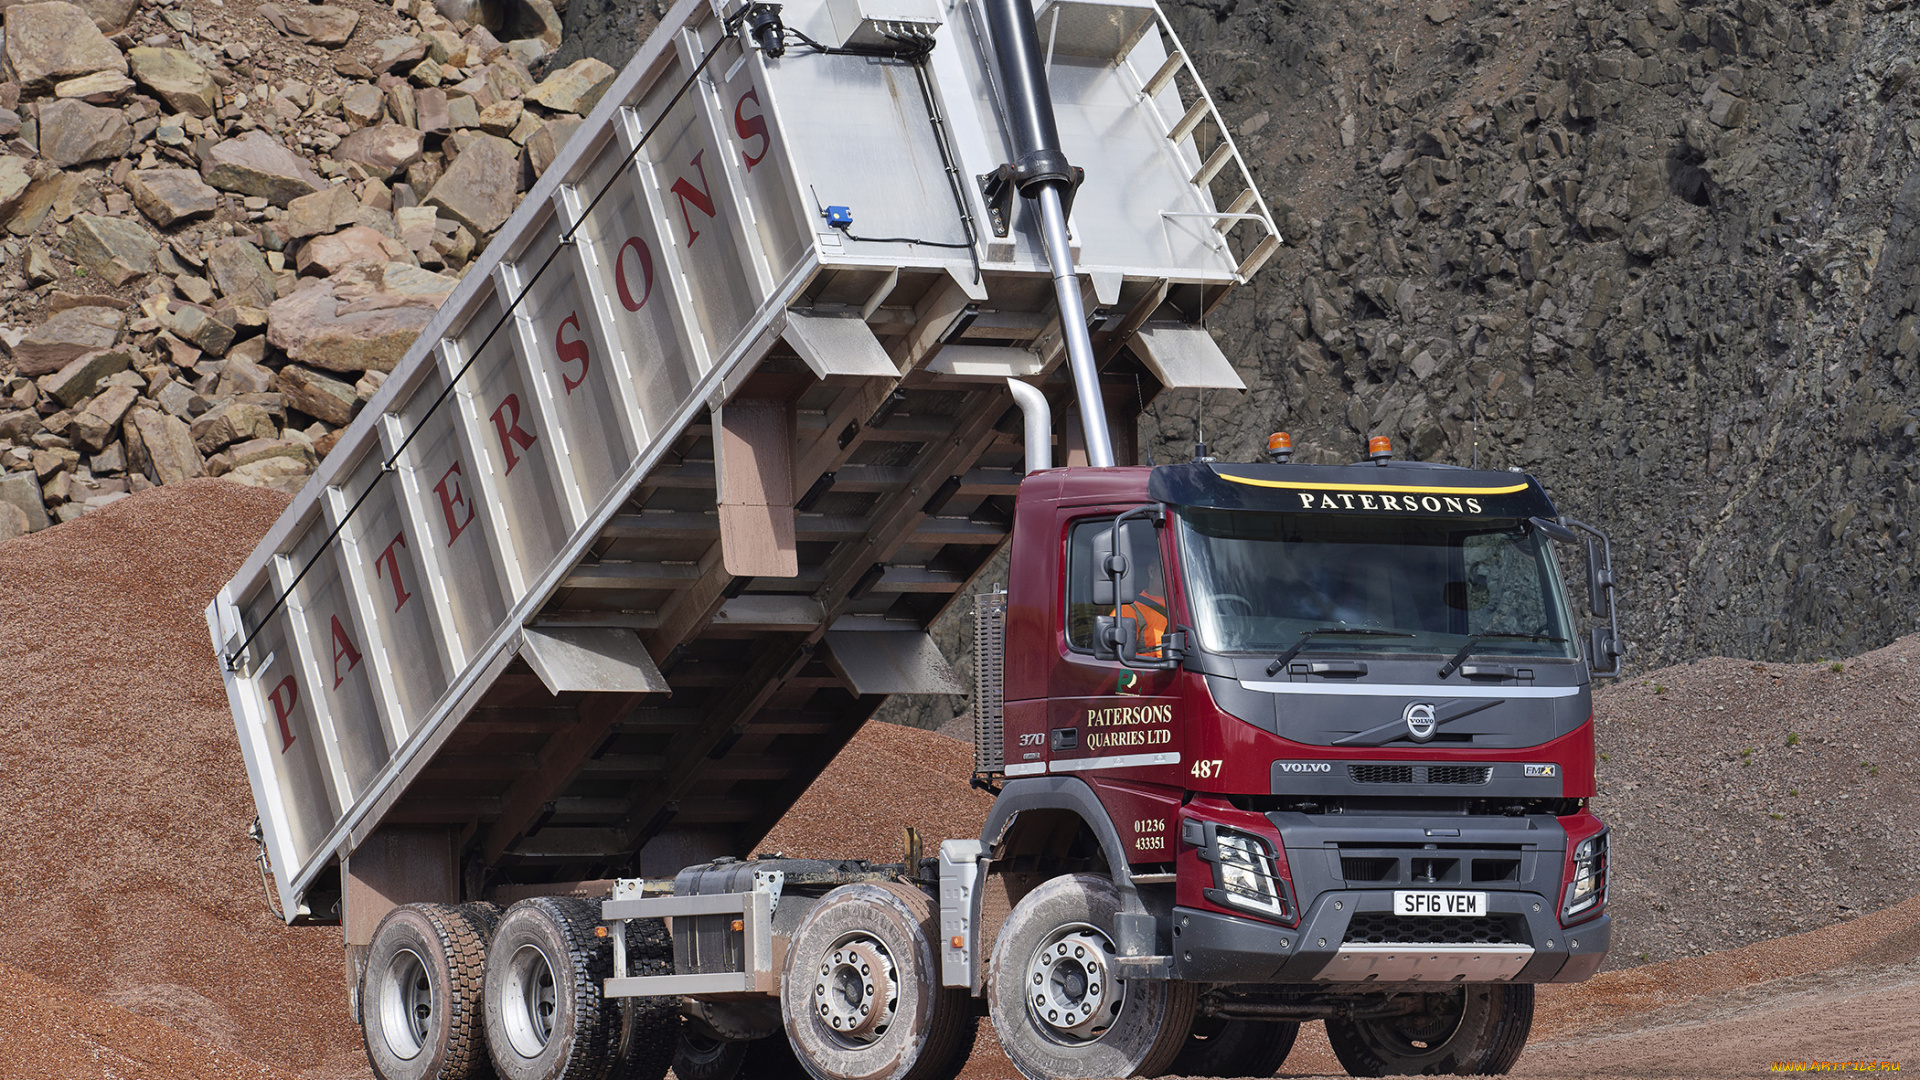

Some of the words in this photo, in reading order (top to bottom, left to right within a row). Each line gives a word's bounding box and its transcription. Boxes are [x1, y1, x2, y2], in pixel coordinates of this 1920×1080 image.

[267, 87, 771, 754] PATERSONS
[1298, 492, 1483, 514] PATERSONS
[1087, 704, 1172, 727] PATERSONS
[1019, 733, 1046, 747] 370
[1087, 731, 1145, 751] QUARRIES
[1147, 729, 1171, 745] LTD
[1190, 760, 1223, 779] 487
[1279, 763, 1332, 773] VOLVO
[1134, 819, 1165, 833] 01236
[1135, 836, 1165, 851] 433351
[1404, 894, 1441, 913] SF16
[1446, 894, 1477, 913] VEM
